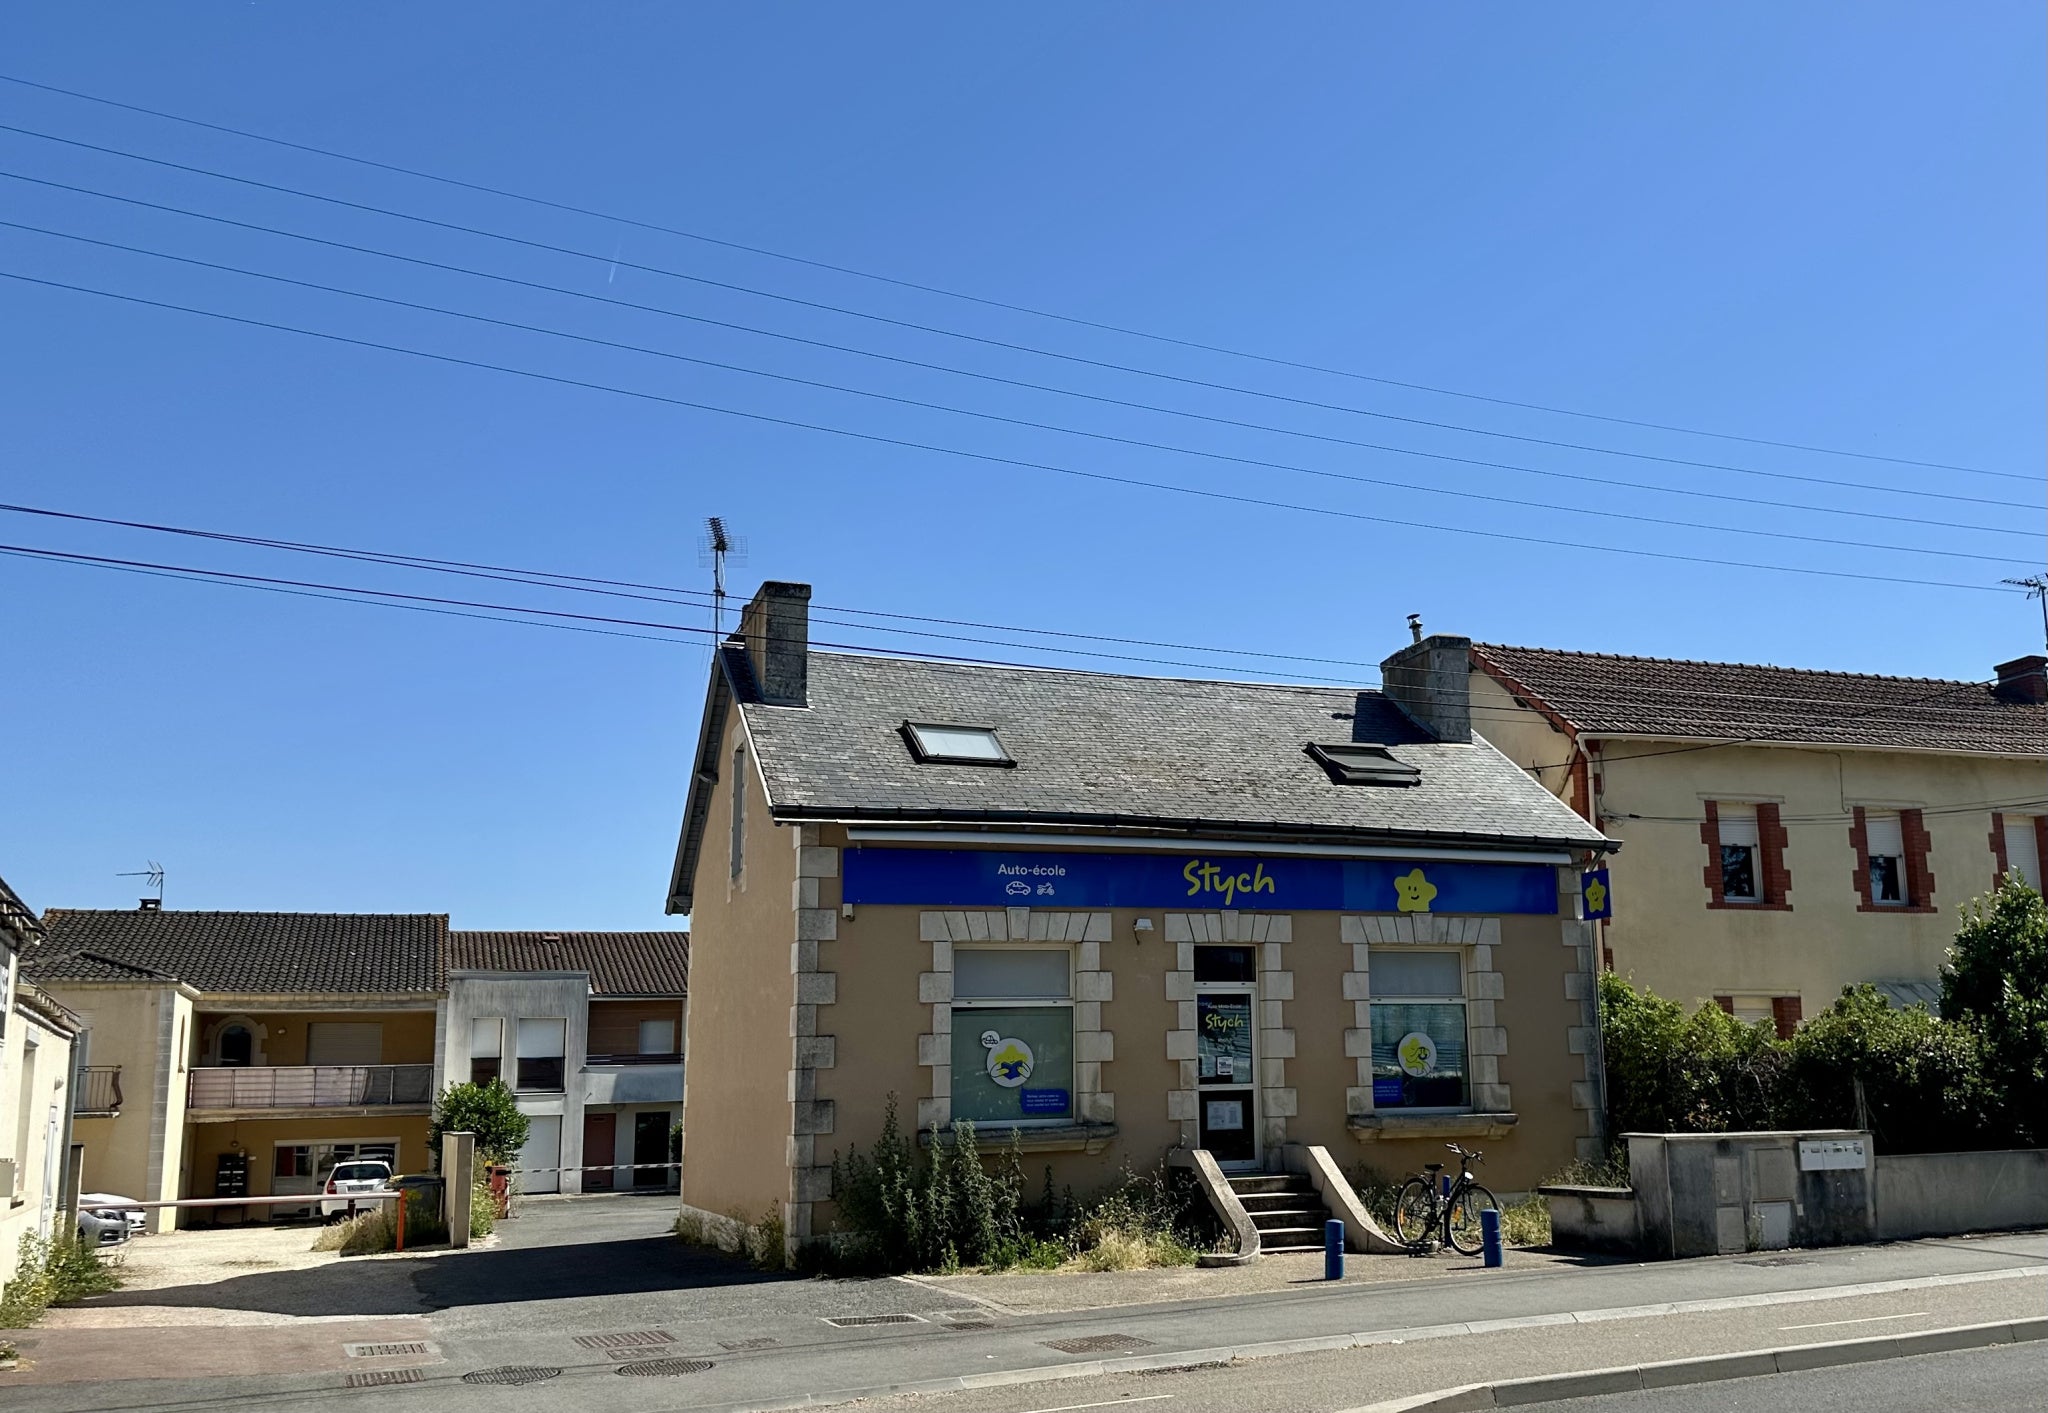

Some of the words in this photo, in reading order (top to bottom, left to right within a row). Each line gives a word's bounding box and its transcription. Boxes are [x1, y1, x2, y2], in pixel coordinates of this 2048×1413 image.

[998, 864, 1066, 876] Auto-école
[1183, 860, 1275, 906] Stych
[1205, 1013, 1244, 1033] Stych
